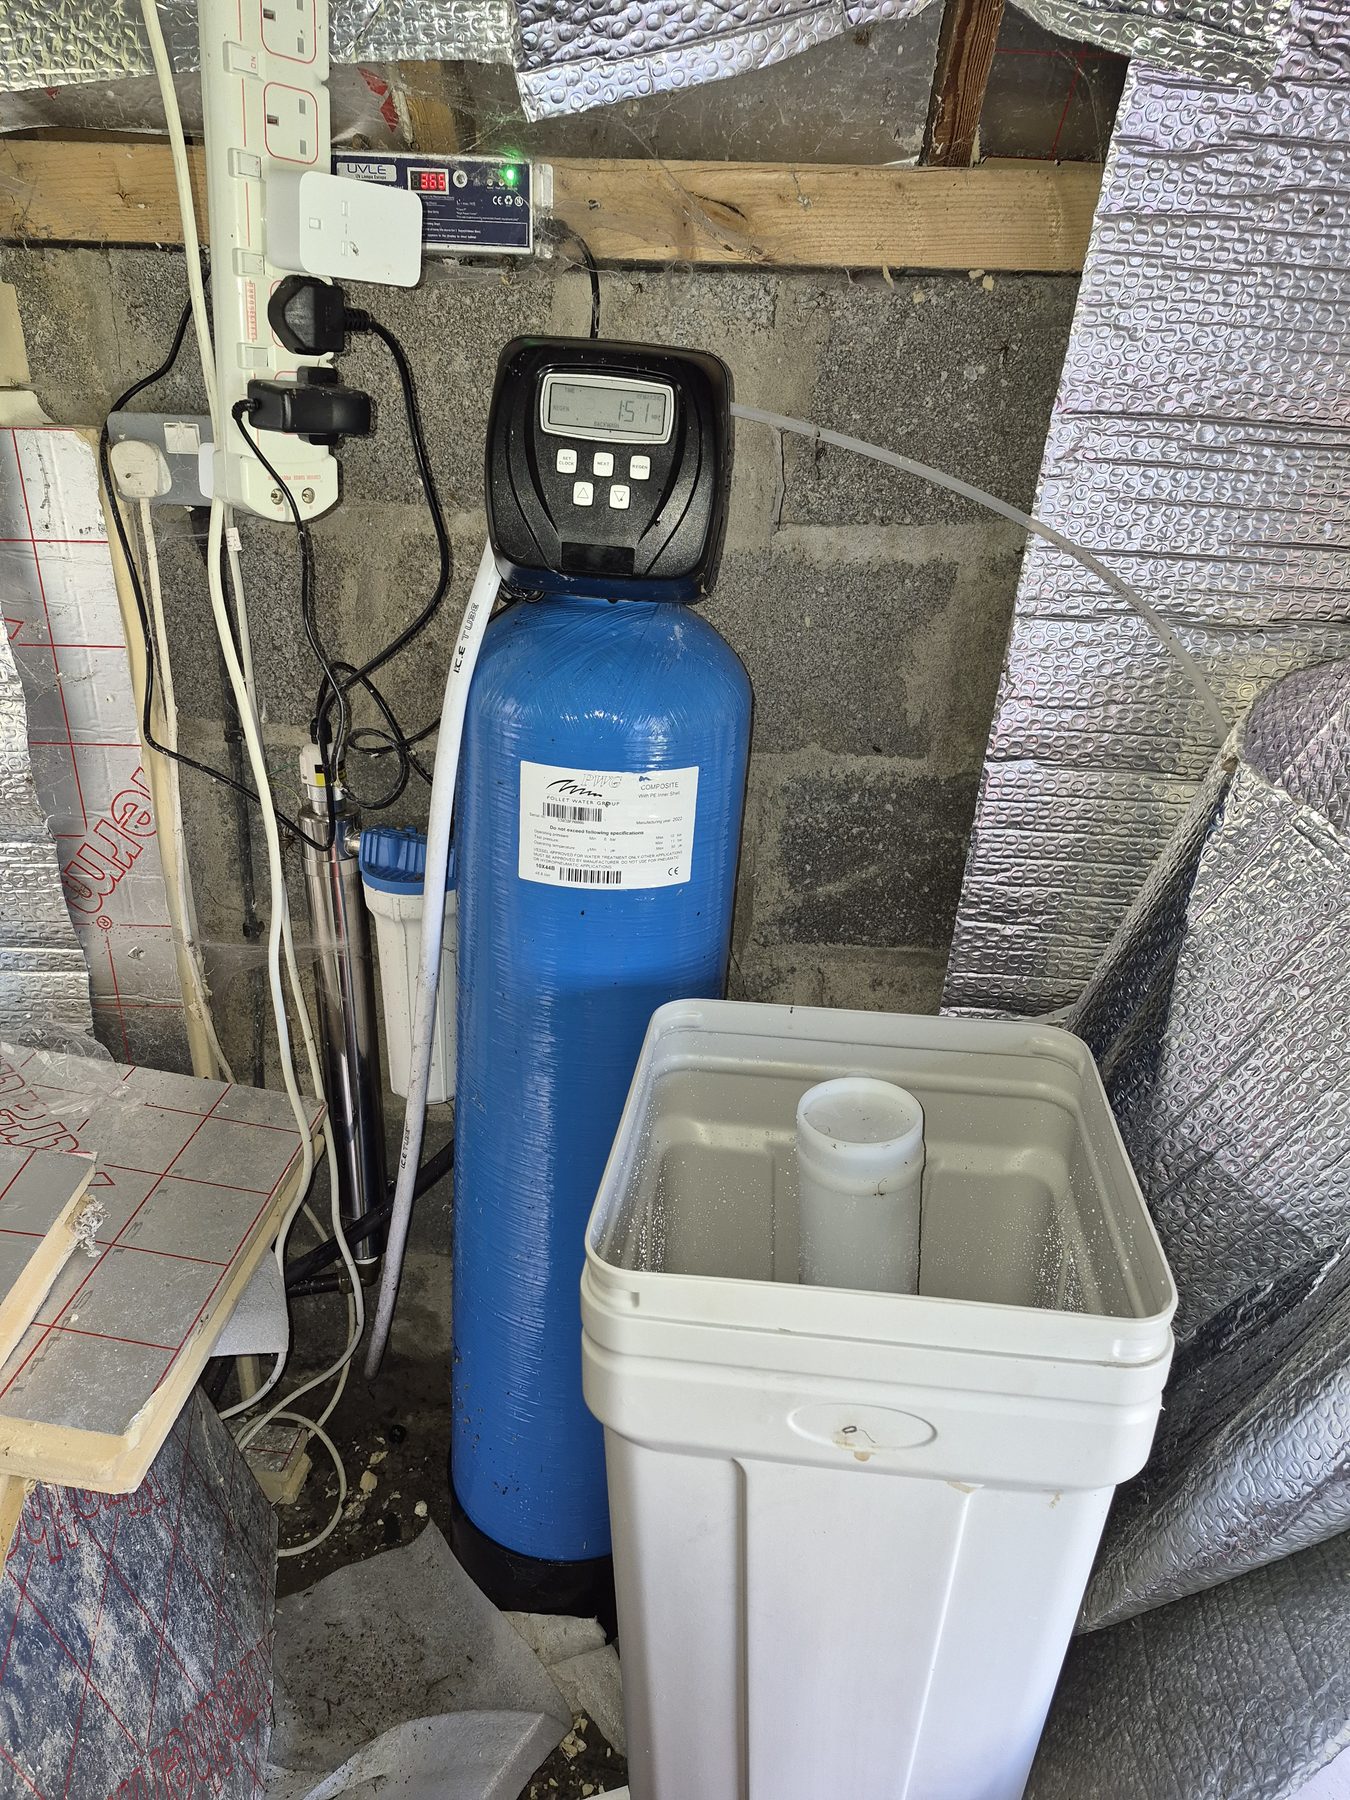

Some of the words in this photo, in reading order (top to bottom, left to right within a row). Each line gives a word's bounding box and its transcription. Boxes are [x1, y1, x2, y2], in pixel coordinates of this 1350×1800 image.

[346, 163, 387, 175] UVLE
[420, 173, 446, 190] 365
[461, 602, 480, 641] TUBE
[640, 782, 679, 791] COMPOSITE
